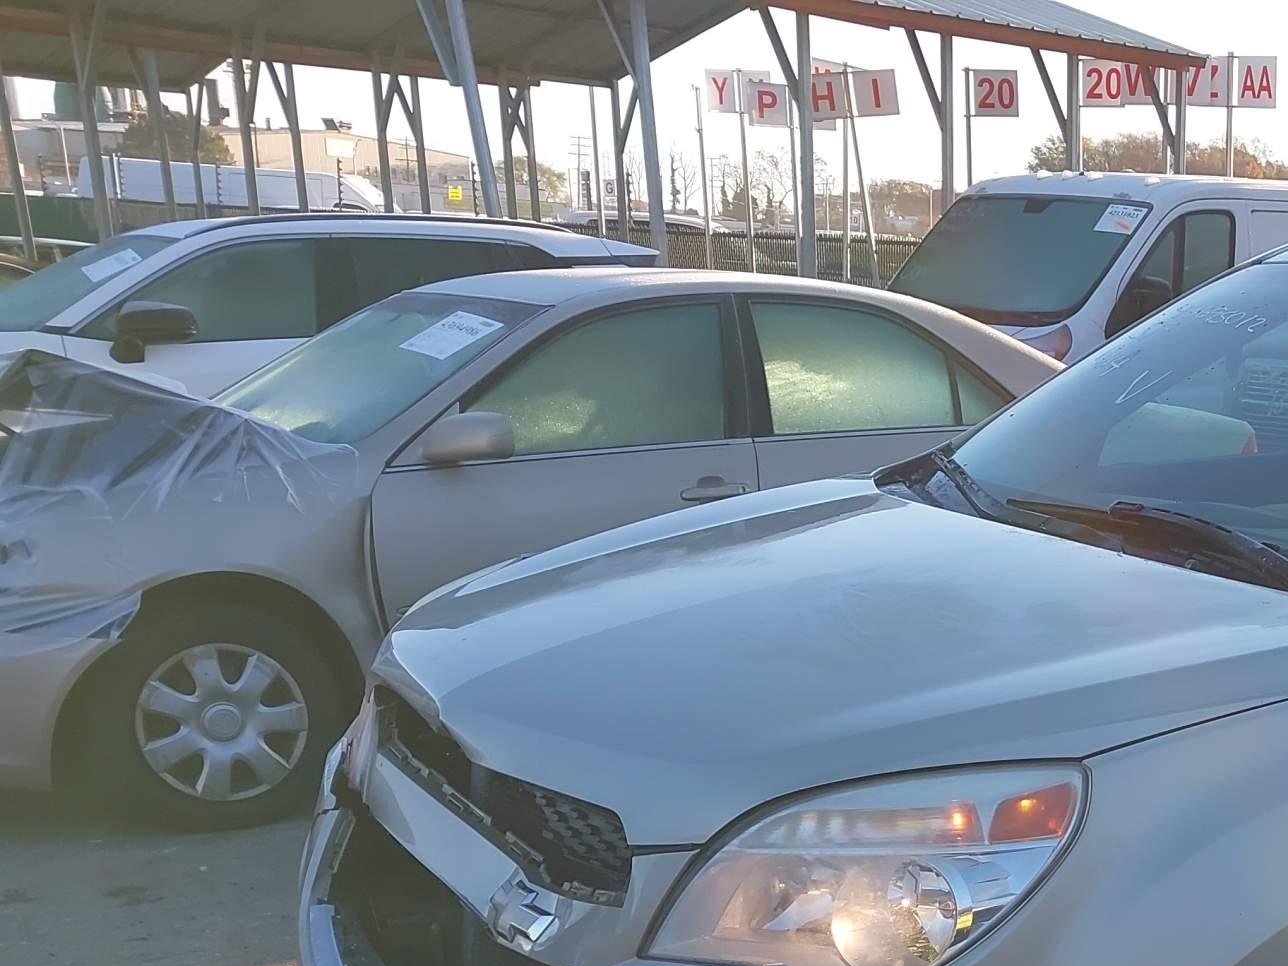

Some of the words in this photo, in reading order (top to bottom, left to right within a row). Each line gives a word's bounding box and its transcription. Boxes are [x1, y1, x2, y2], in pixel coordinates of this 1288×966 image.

[712, 77, 728, 104] Y
[812, 81, 836, 112] H
[977, 78, 1015, 109] 20
[1086, 68, 1121, 99] 20
[1241, 65, 1273, 99] AA
[757, 90, 777, 118] P
